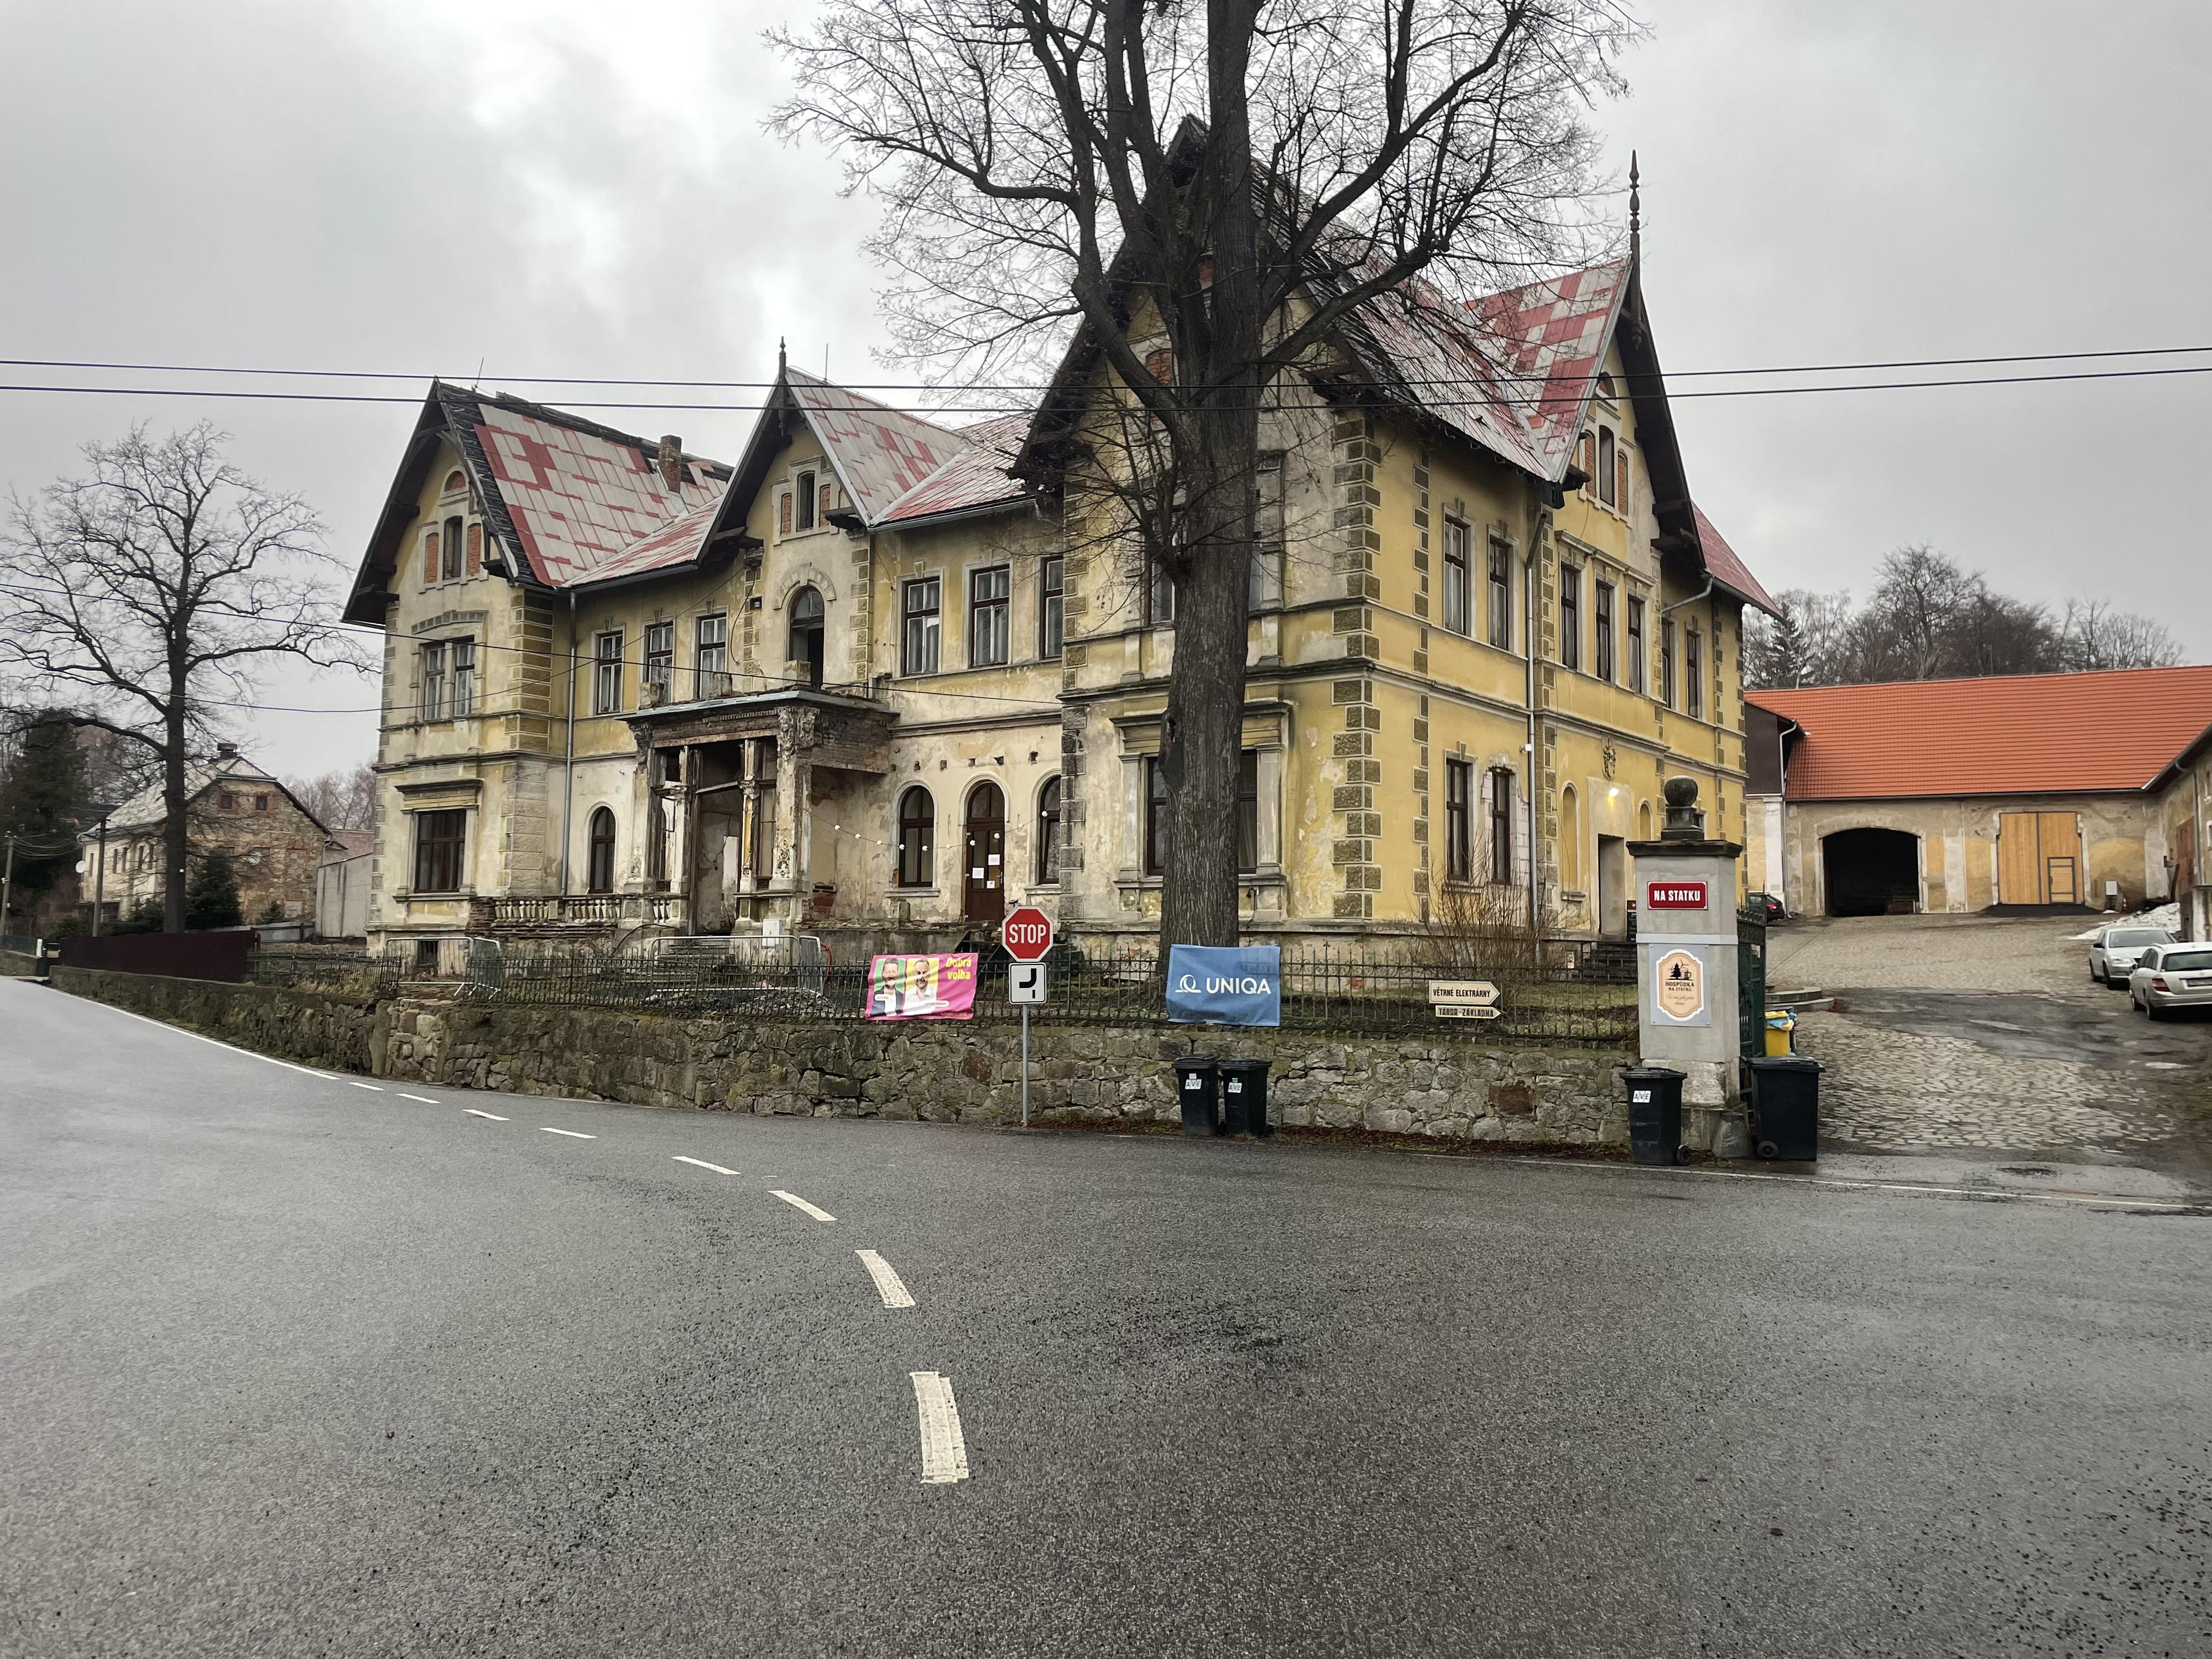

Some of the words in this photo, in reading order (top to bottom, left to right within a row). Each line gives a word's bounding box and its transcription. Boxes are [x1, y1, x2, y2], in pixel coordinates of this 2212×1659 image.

[1654, 890, 1666, 901] NA
[1668, 890, 1700, 901] STATKU
[1009, 924, 1046, 943] STOP
[946, 956, 972, 967] Dobrá
[947, 969, 971, 979] volba
[1206, 977, 1271, 994] UNIQA
[1433, 987, 1454, 997] VĚTRNÉ
[1455, 988, 1490, 998] ELEKTRÁRNY
